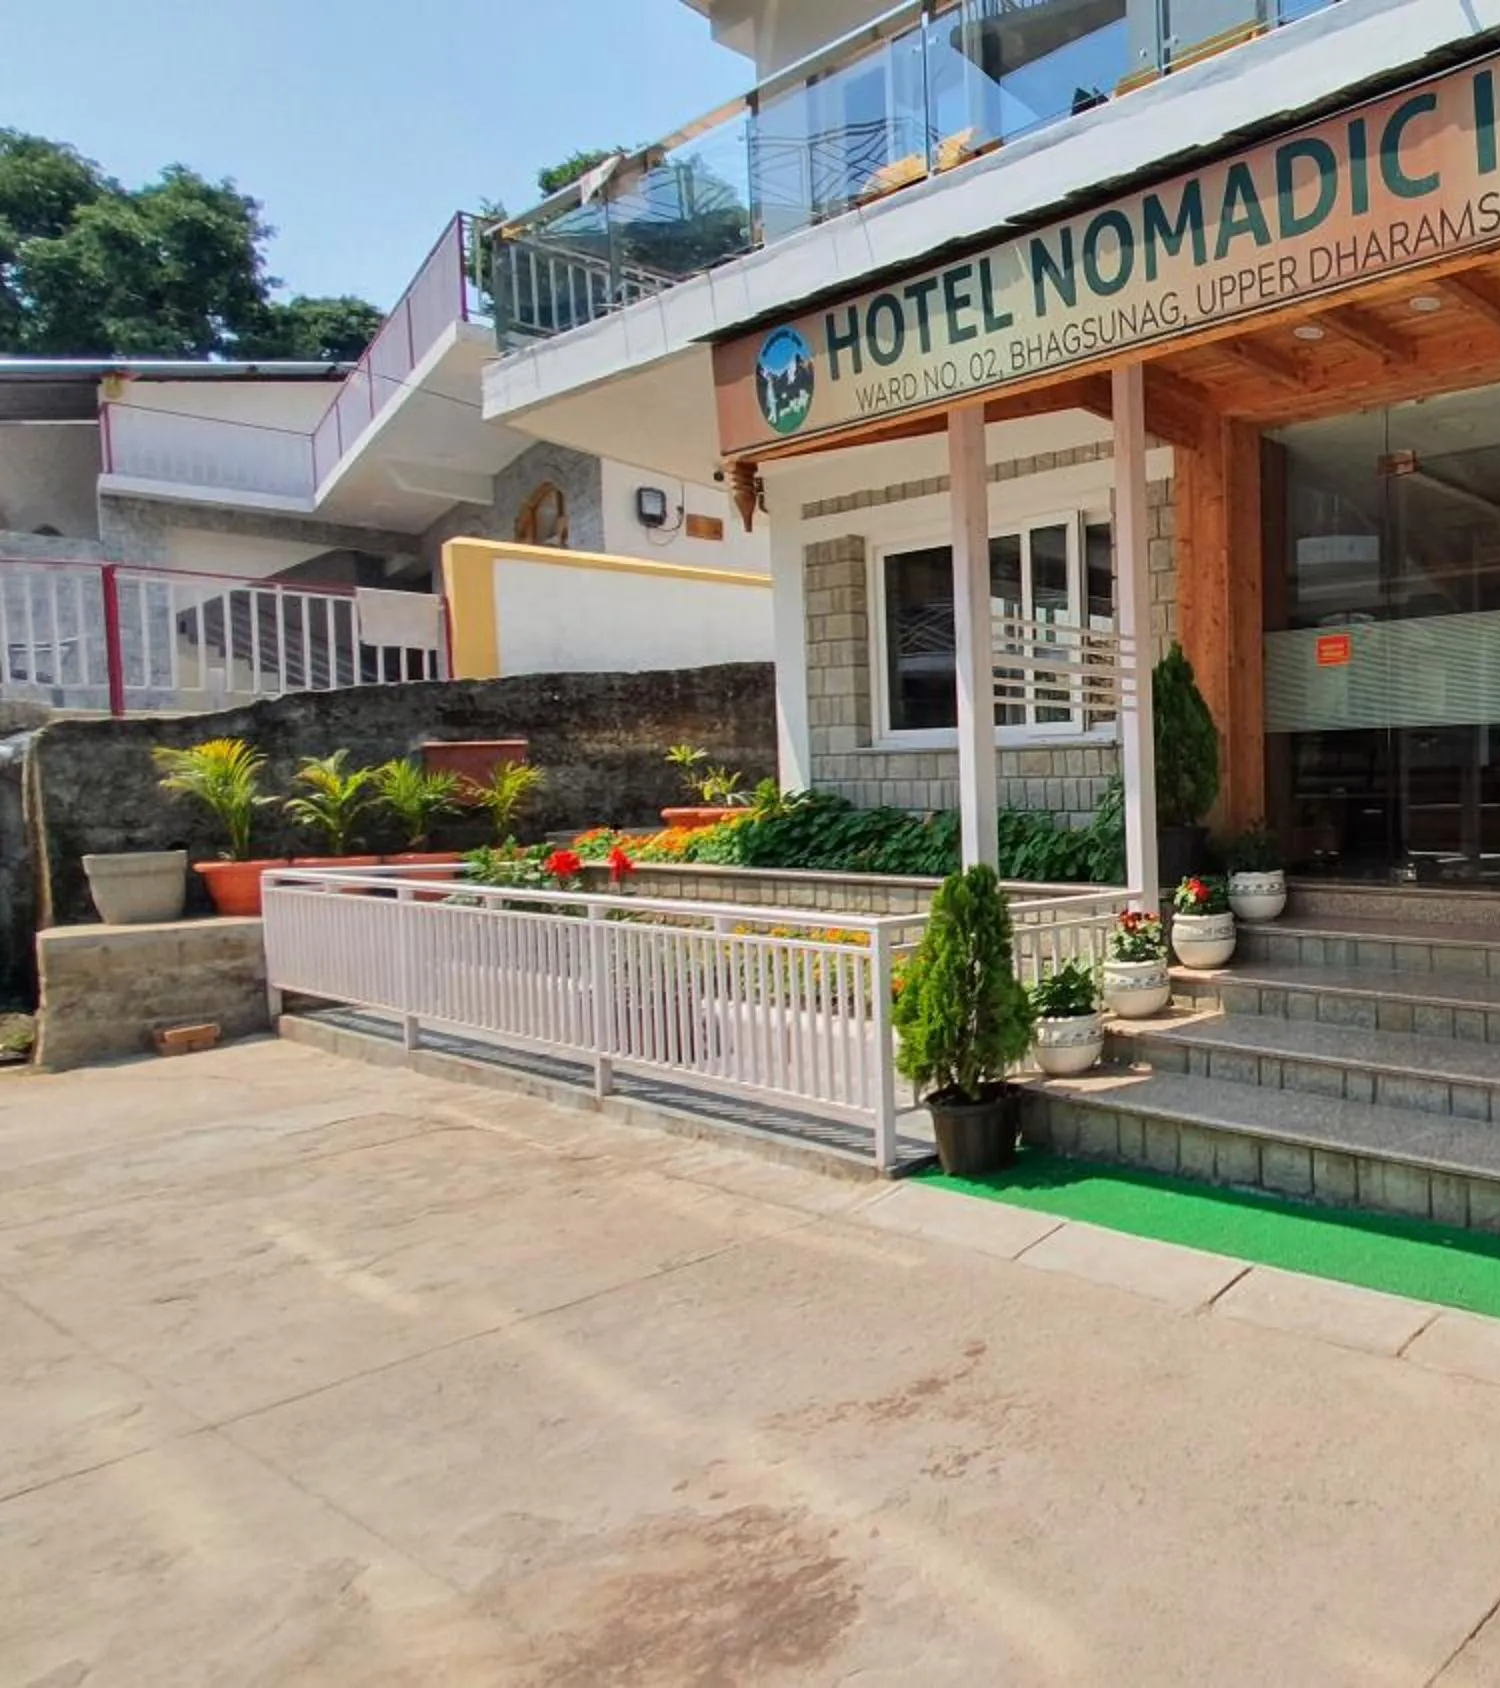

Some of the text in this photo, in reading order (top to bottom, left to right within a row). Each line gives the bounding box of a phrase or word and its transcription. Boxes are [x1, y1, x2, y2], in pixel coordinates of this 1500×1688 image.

[825, 257, 1013, 381] HOTEL
[1029, 92, 1441, 318] NOMADIC
[855, 371, 918, 413] WARD
[923, 364, 964, 396] NO.
[969, 355, 1003, 382] 02,
[1010, 291, 1188, 371] BHAGSUNAG,
[1196, 255, 1299, 316] UPPER
